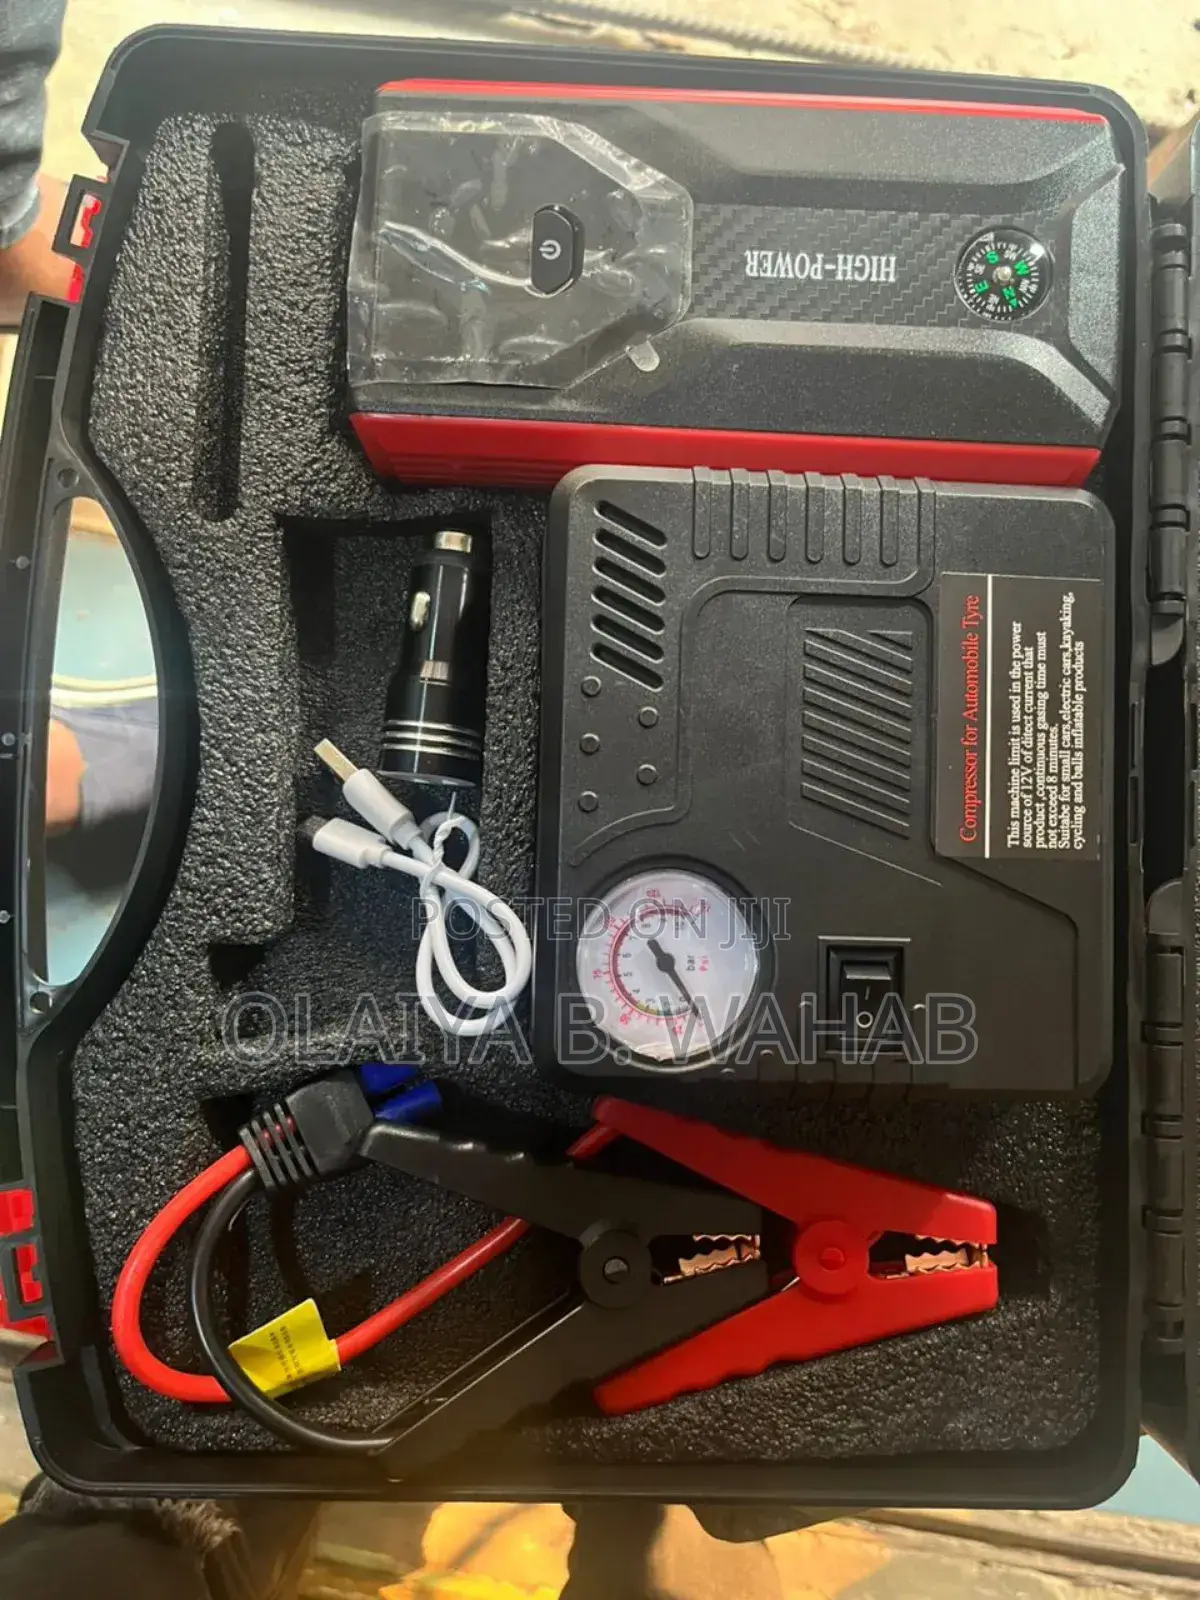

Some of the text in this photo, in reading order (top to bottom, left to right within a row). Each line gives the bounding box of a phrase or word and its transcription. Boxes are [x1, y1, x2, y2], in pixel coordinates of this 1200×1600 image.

[744, 250, 897, 283] HIGH-POWER
[974, 280, 989, 293] E
[1022, 646, 1034, 669] that
[1036, 631, 1046, 660] must
[1024, 671, 1034, 713] current
[1035, 663, 1046, 689] time
[959, 595, 983, 842] Compressor for Automobile Tyre
[1035, 691, 1049, 730] gasing
[1007, 620, 1024, 848] This machine limit is used in the power
[1046, 723, 1058, 773] minutes.
[1071, 641, 1086, 850] cycling and balls inflatable products
[1022, 748, 1033, 763] of
[1059, 750, 1070, 782] small
[1021, 765, 1033, 790] 12V
[1059, 784, 1070, 802] for
[1021, 791, 1033, 806] of
[1046, 785, 1058, 827] exceed
[1023, 809, 1033, 848] source
[1034, 802, 1048, 848] product
[1047, 829, 1058, 849] not
